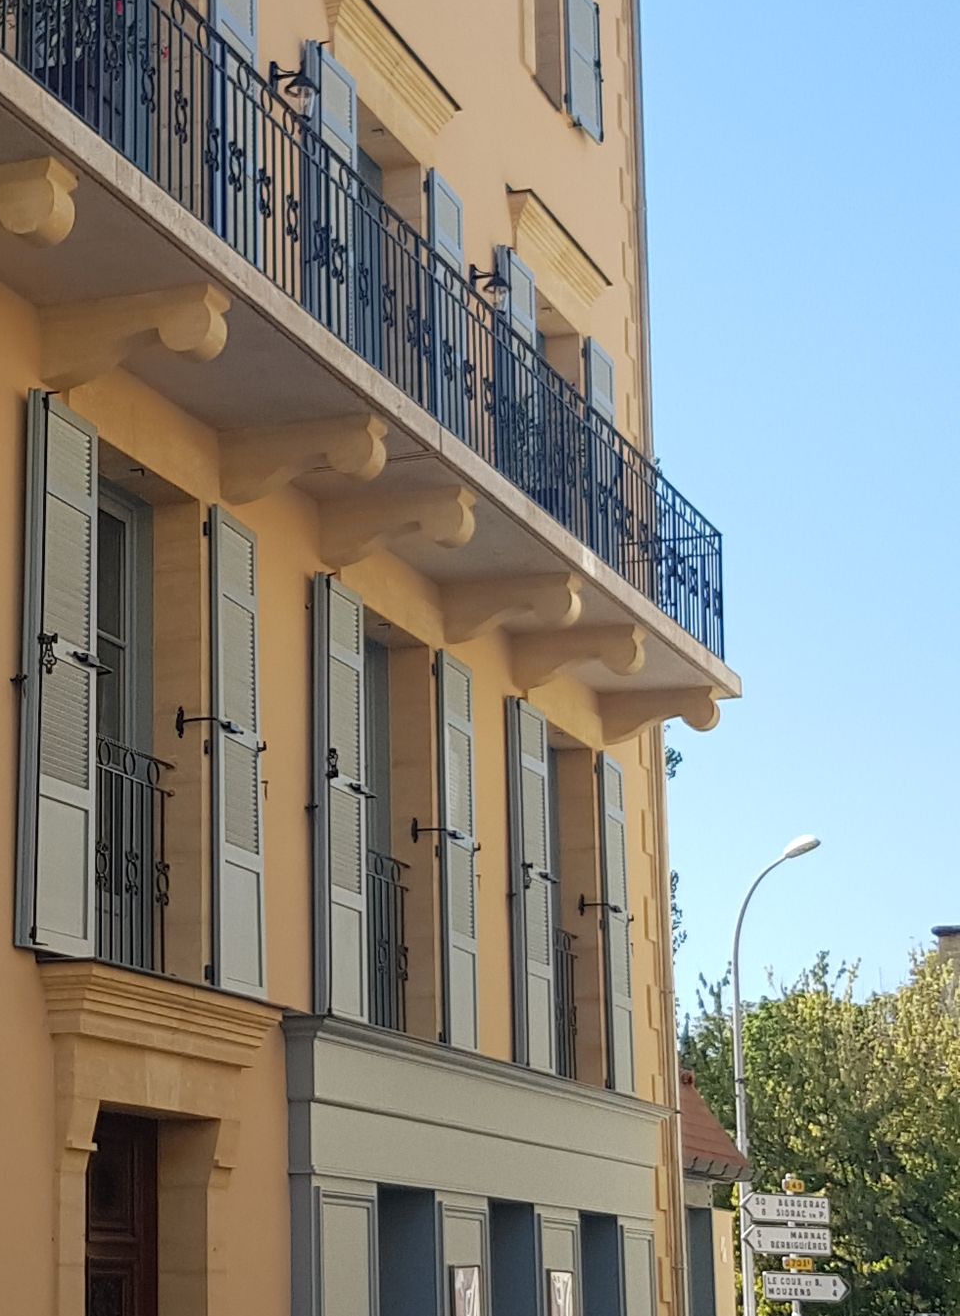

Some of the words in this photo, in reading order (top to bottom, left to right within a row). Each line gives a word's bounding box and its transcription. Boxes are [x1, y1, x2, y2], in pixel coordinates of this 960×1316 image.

[778, 1199, 826, 1209] BERGERAC
[776, 1209, 806, 1218] SIORAC
[790, 1231, 827, 1240] MARNAC
[767, 1277, 777, 1285] LE
[780, 1277, 801, 1286] COUX
[768, 1287, 811, 1297] MOUZENS
